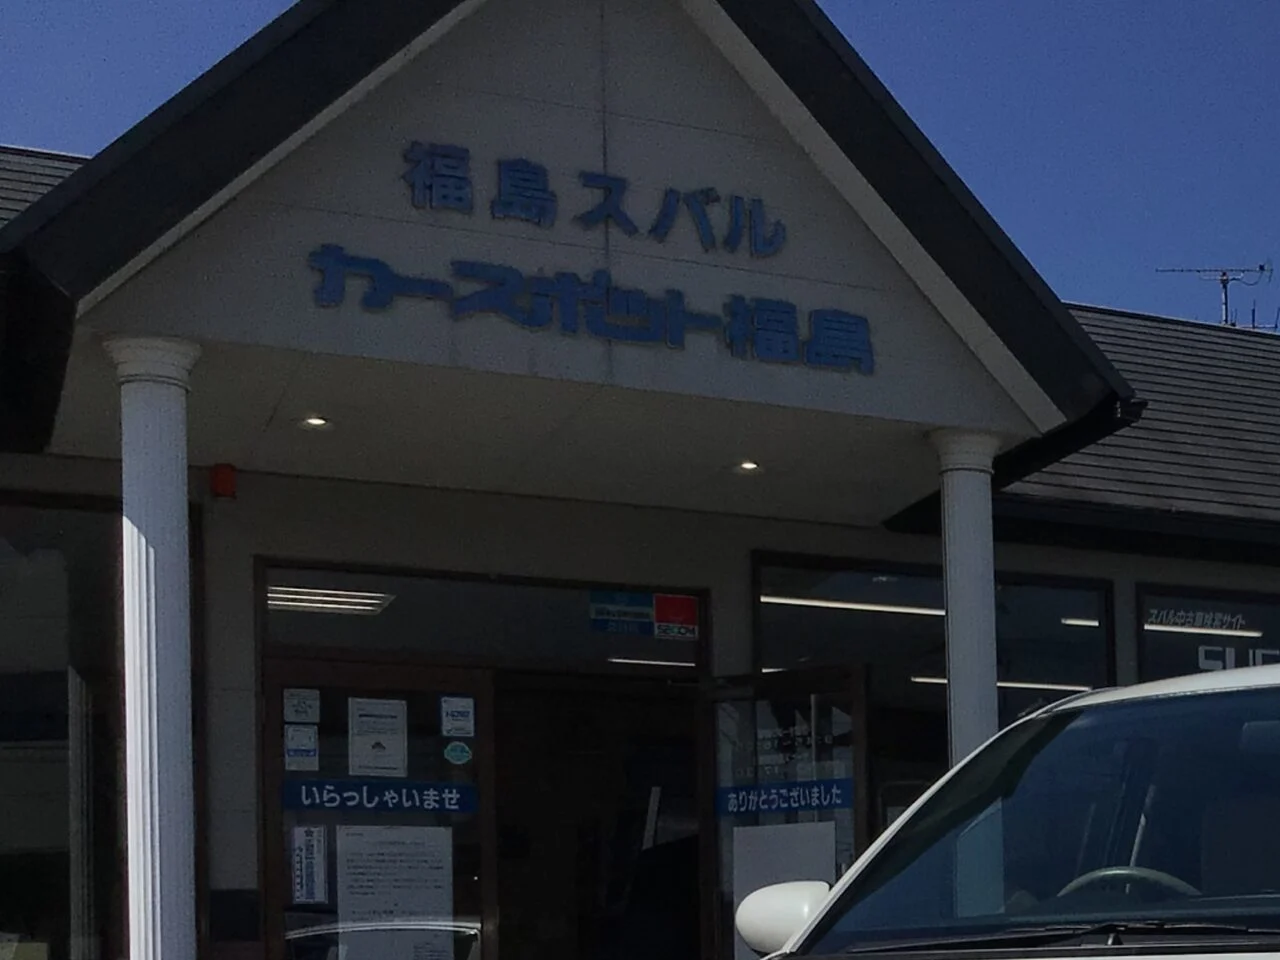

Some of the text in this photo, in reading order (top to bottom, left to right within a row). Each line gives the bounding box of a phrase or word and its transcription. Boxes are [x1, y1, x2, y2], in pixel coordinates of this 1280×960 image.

[402, 140, 787, 258] 福島スバル
[307, 243, 876, 375] カースポット福島
[301, 785, 461, 811] いらっしゃいませ
[728, 783, 842, 813] ありがとうございました
